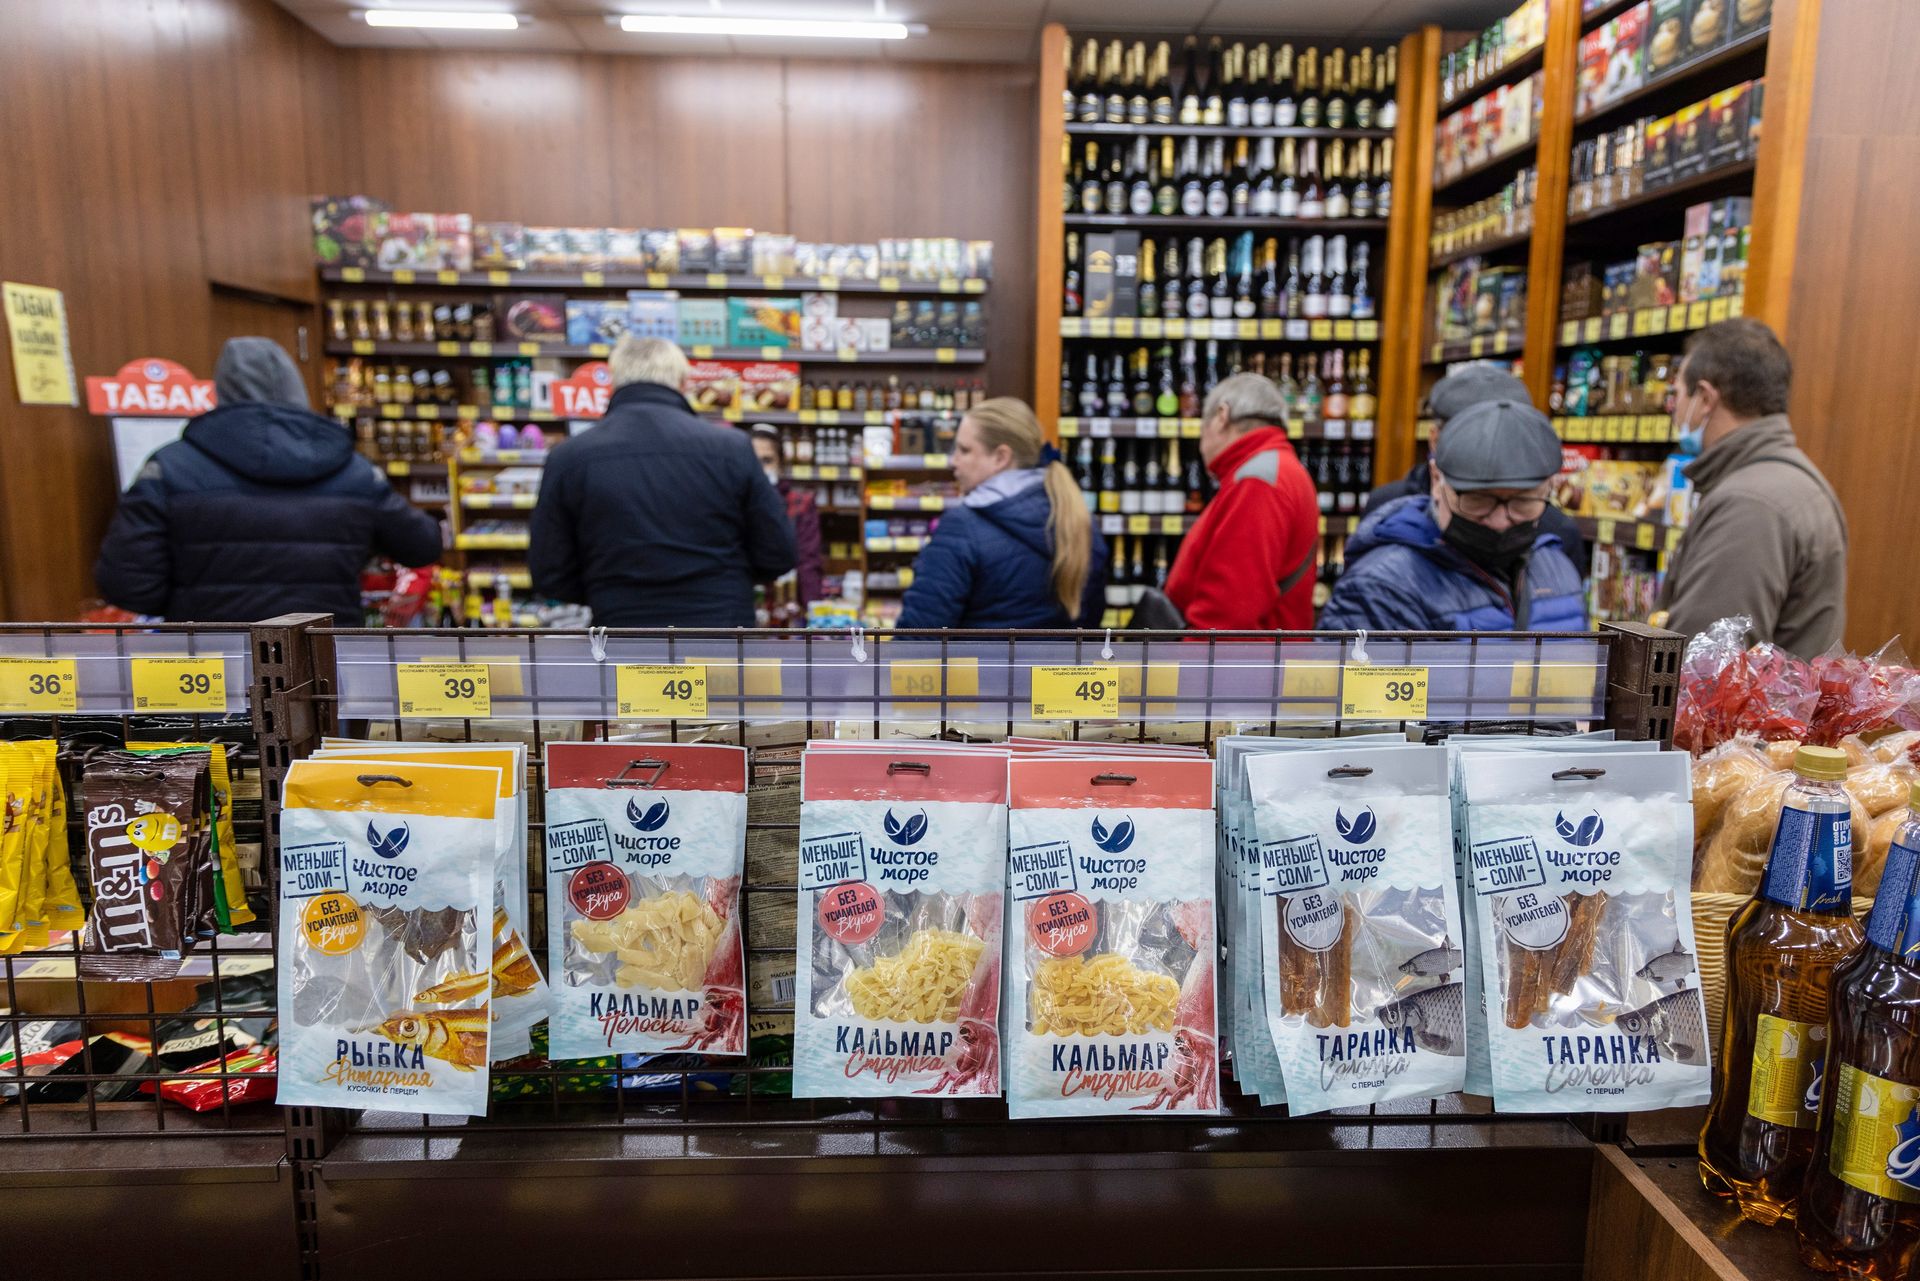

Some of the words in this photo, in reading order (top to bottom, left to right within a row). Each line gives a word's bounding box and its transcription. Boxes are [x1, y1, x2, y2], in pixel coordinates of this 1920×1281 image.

[101, 382, 214, 412] ТАБАК
[560, 386, 608, 413] ТАБ
[29, 674, 61, 695] 36
[62, 673, 73, 681] 89
[179, 673, 210, 694] 39
[444, 678, 475, 699] 39
[476, 677, 487, 685] 99
[662, 679, 692, 700] 49
[1075, 681, 1105, 701] 49
[1385, 681, 1414, 702] 39
[549, 826, 605, 848] МЕНЬШЕ
[614, 833, 681, 851] Чистое
[284, 850, 341, 872] МЕНЬШЕ
[563, 847, 598, 864] СОЛИ
[625, 850, 672, 868] море
[802, 840, 859, 864] МЕНЬШЕ
[870, 847, 938, 866] Чистое
[1012, 850, 1067, 874] МЕНЬШЕ
[1263, 844, 1318, 868] МЕНЬШЕ
[1328, 847, 1387, 865] Чистое
[1473, 843, 1533, 869] МЕНЬШЕ
[1545, 849, 1621, 867] Чистое
[353, 859, 418, 882] Чистое
[815, 864, 849, 882] СОЛИ
[879, 867, 929, 885] море
[1079, 857, 1147, 874] Чистое
[1341, 866, 1378, 884] море
[298, 874, 333, 890] СОЛИ
[585, 870, 605, 884] БЕЗ
[1025, 874, 1061, 892] СОЛИ
[1091, 874, 1138, 893] море
[1278, 868, 1312, 886] СОЛИ
[1490, 868, 1526, 886] СОЛИ
[1560, 868, 1612, 885] море
[362, 881, 408, 899] море
[573, 879, 625, 901] УСИЛИТЕЛЕЙ
[837, 889, 857, 906] БЕЗ
[1810, 891, 1843, 908] fresh
[320, 899, 341, 917] БЕЗ
[825, 898, 878, 923] УСИЛИТЕЛЕЙ
[1048, 901, 1069, 917] БЕЗ
[1302, 894, 1323, 911] БЕЗ
[1516, 893, 1538, 910] БЕЗ
[306, 909, 360, 934] УСИЛИТЕЛЕЙ
[1036, 907, 1090, 934] УСИЛИТЕЛЕЙ
[1290, 900, 1340, 930] УСИЛИТЕЛЕЙ
[1505, 901, 1562, 928] УСИЛИТЕЛЕЙ
[590, 992, 699, 1020] КАЛЬМАР
[598, 1010, 688, 1047] Полоски
[836, 1025, 953, 1057] КАЛЬМАР
[1316, 1025, 1417, 1062] ТАРАНКА
[1542, 1035, 1661, 1065] ТАРАНКА
[336, 1038, 424, 1070] РЫБКА
[1053, 1043, 1169, 1072] КАЛЬМАР
[317, 1056, 435, 1088] Янтарная
[844, 1048, 946, 1084] Стружка
[1319, 1051, 1410, 1093] Соломка
[1061, 1067, 1164, 1101] Стружка
[1351, 1081, 1358, 1090] С
[1359, 1079, 1385, 1090] ПЕРЦЕМ
[1545, 1059, 1655, 1095] Соломка
[347, 1084, 381, 1095] КУСОЧКИ
[383, 1086, 389, 1095] С
[389, 1086, 419, 1097] ПЕРЦЕМ
[1586, 1087, 1592, 1095] С
[1593, 1087, 1625, 1096] ПЕРЦЕМ
